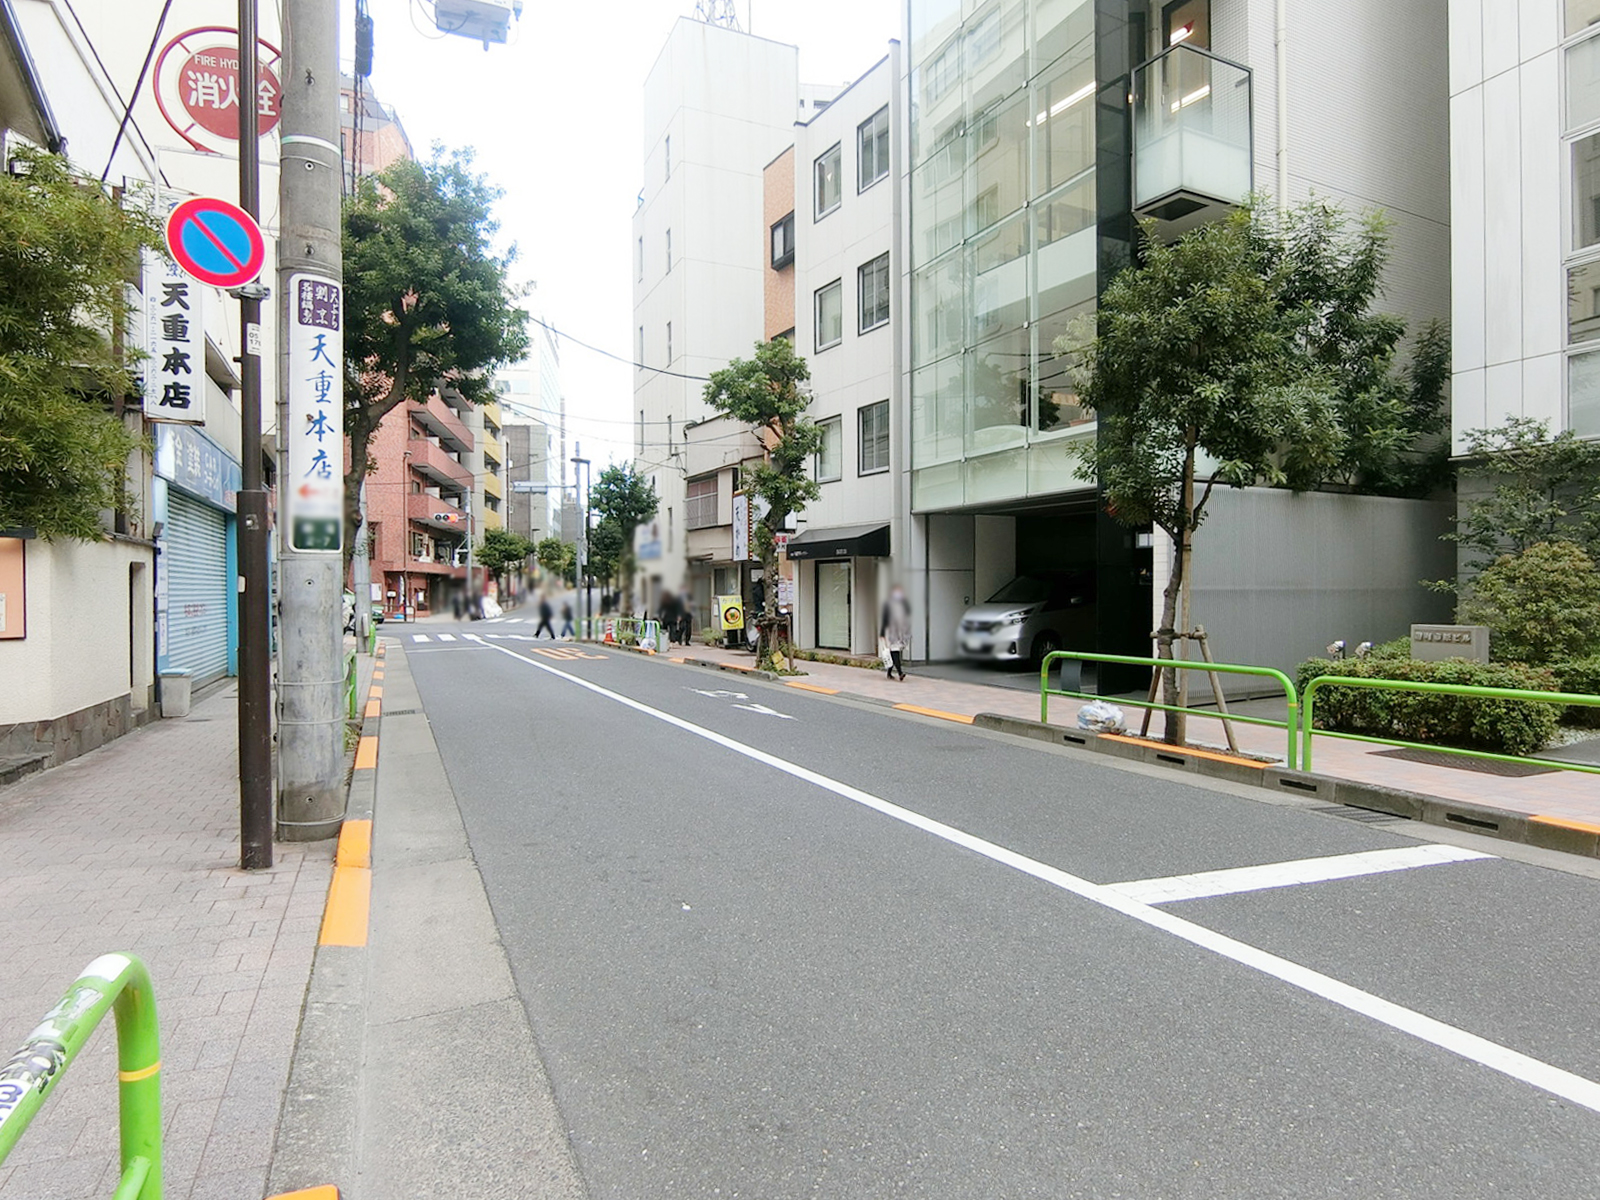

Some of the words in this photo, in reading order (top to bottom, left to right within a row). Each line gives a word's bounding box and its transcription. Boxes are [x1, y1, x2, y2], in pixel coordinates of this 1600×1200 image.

[194, 54, 217, 66] FIRE
[159, 282, 192, 409] 天重本店
[303, 333, 336, 480] 天重本店
